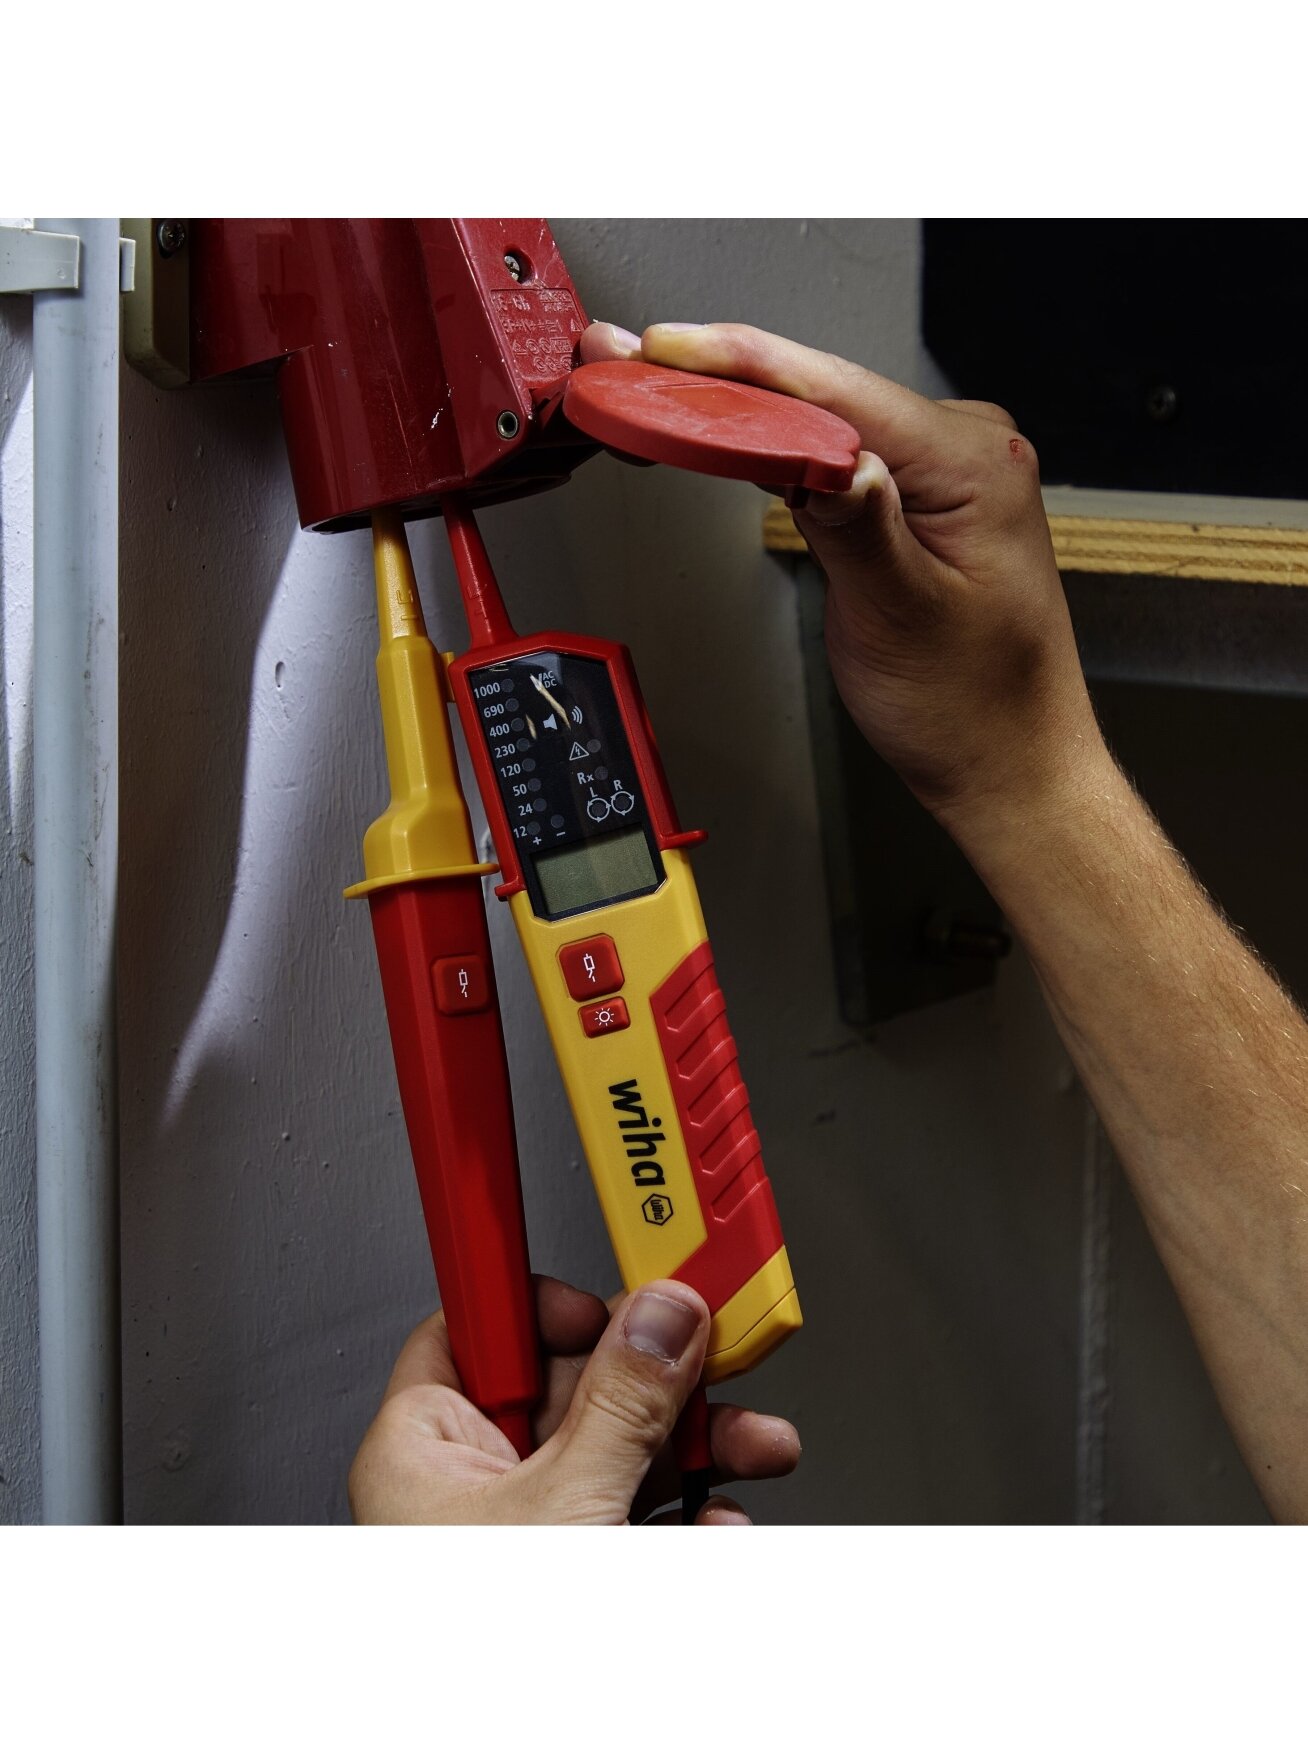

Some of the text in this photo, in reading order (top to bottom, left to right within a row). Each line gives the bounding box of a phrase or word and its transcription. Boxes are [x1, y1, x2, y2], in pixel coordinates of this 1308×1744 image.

[543, 670, 555, 681] AC
[473, 682, 501, 699] 1000
[544, 678, 558, 689] DC
[483, 703, 505, 719] 690
[489, 722, 510, 738] 400
[494, 743, 516, 759] 230
[500, 762, 522, 779] 120
[577, 771, 595, 785] Rx
[613, 779, 623, 791] R
[512, 783, 528, 797] 50
[590, 786, 599, 799] L
[518, 802, 534, 817] 24
[513, 825, 528, 839] 12
[608, 1079, 666, 1187] wiha
